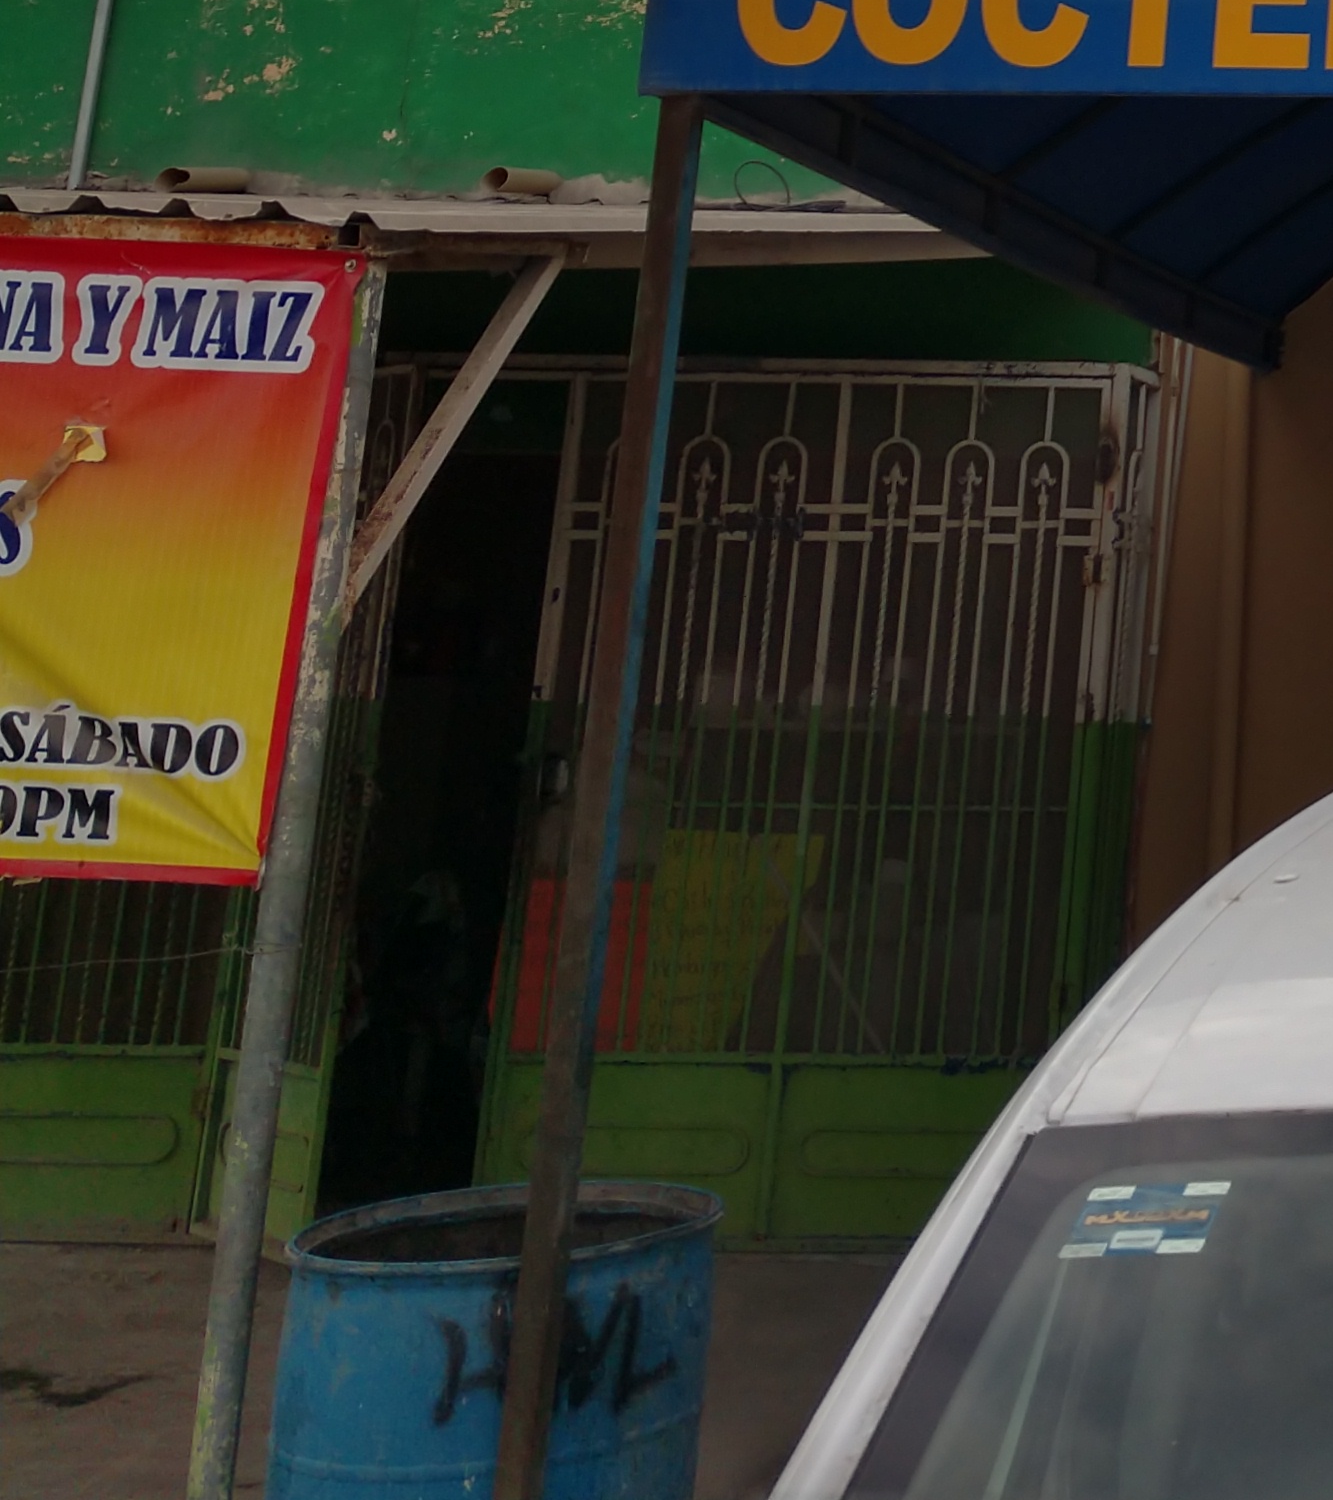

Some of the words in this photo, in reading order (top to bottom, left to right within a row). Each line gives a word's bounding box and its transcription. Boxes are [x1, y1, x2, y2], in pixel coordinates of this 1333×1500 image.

[84, 283, 132, 355] Y
[142, 286, 315, 363] MAIZ
[0, 704, 240, 776] SÁBADO
